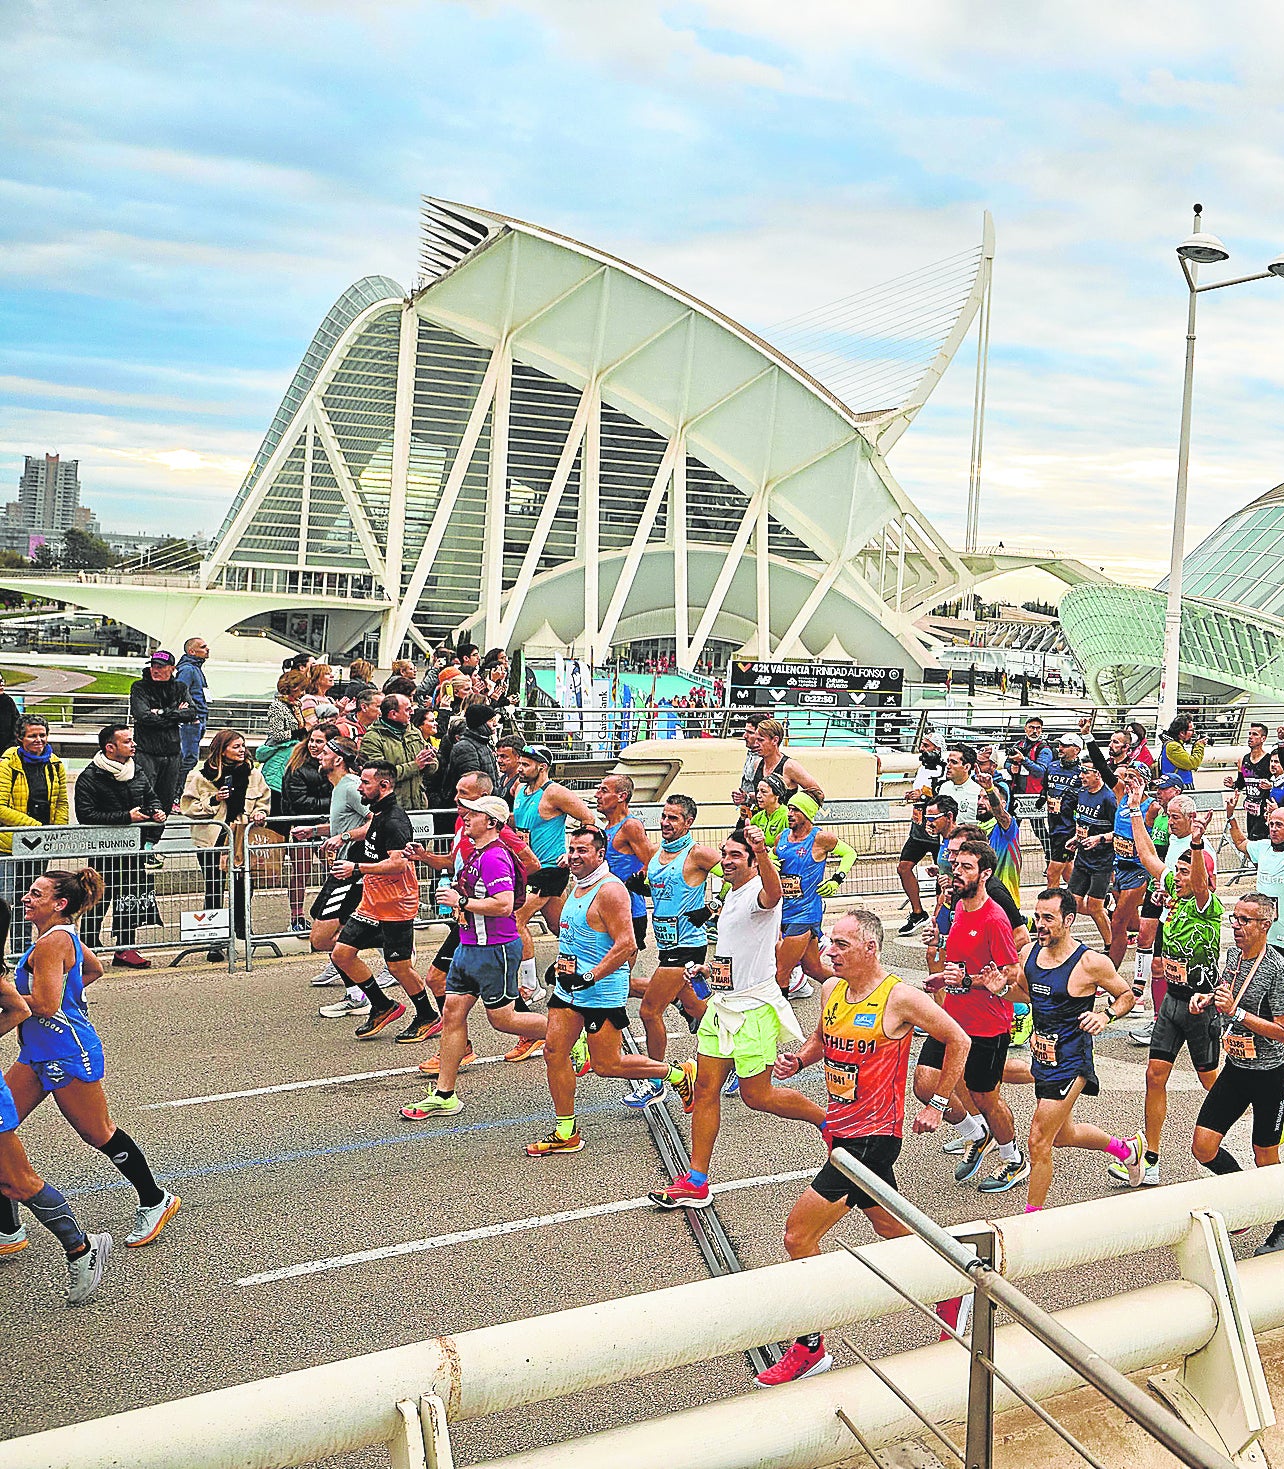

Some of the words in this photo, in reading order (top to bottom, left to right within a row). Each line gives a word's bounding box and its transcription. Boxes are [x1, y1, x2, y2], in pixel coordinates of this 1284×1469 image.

[752, 663, 770, 674] 42K
[771, 664, 810, 675] VALENCIA
[811, 666, 847, 677] TRINIDAD
[848, 667, 885, 678] ALFONSO
[43, 842, 77, 852] CIUDAD
[79, 841, 97, 851] DEL
[98, 839, 136, 850] RUNNING
[857, 1040, 877, 1054] 91
[827, 1071, 845, 1086] 11941
[164, 1195, 173, 1209] HOKA
[87, 1248, 98, 1271] HOKA
